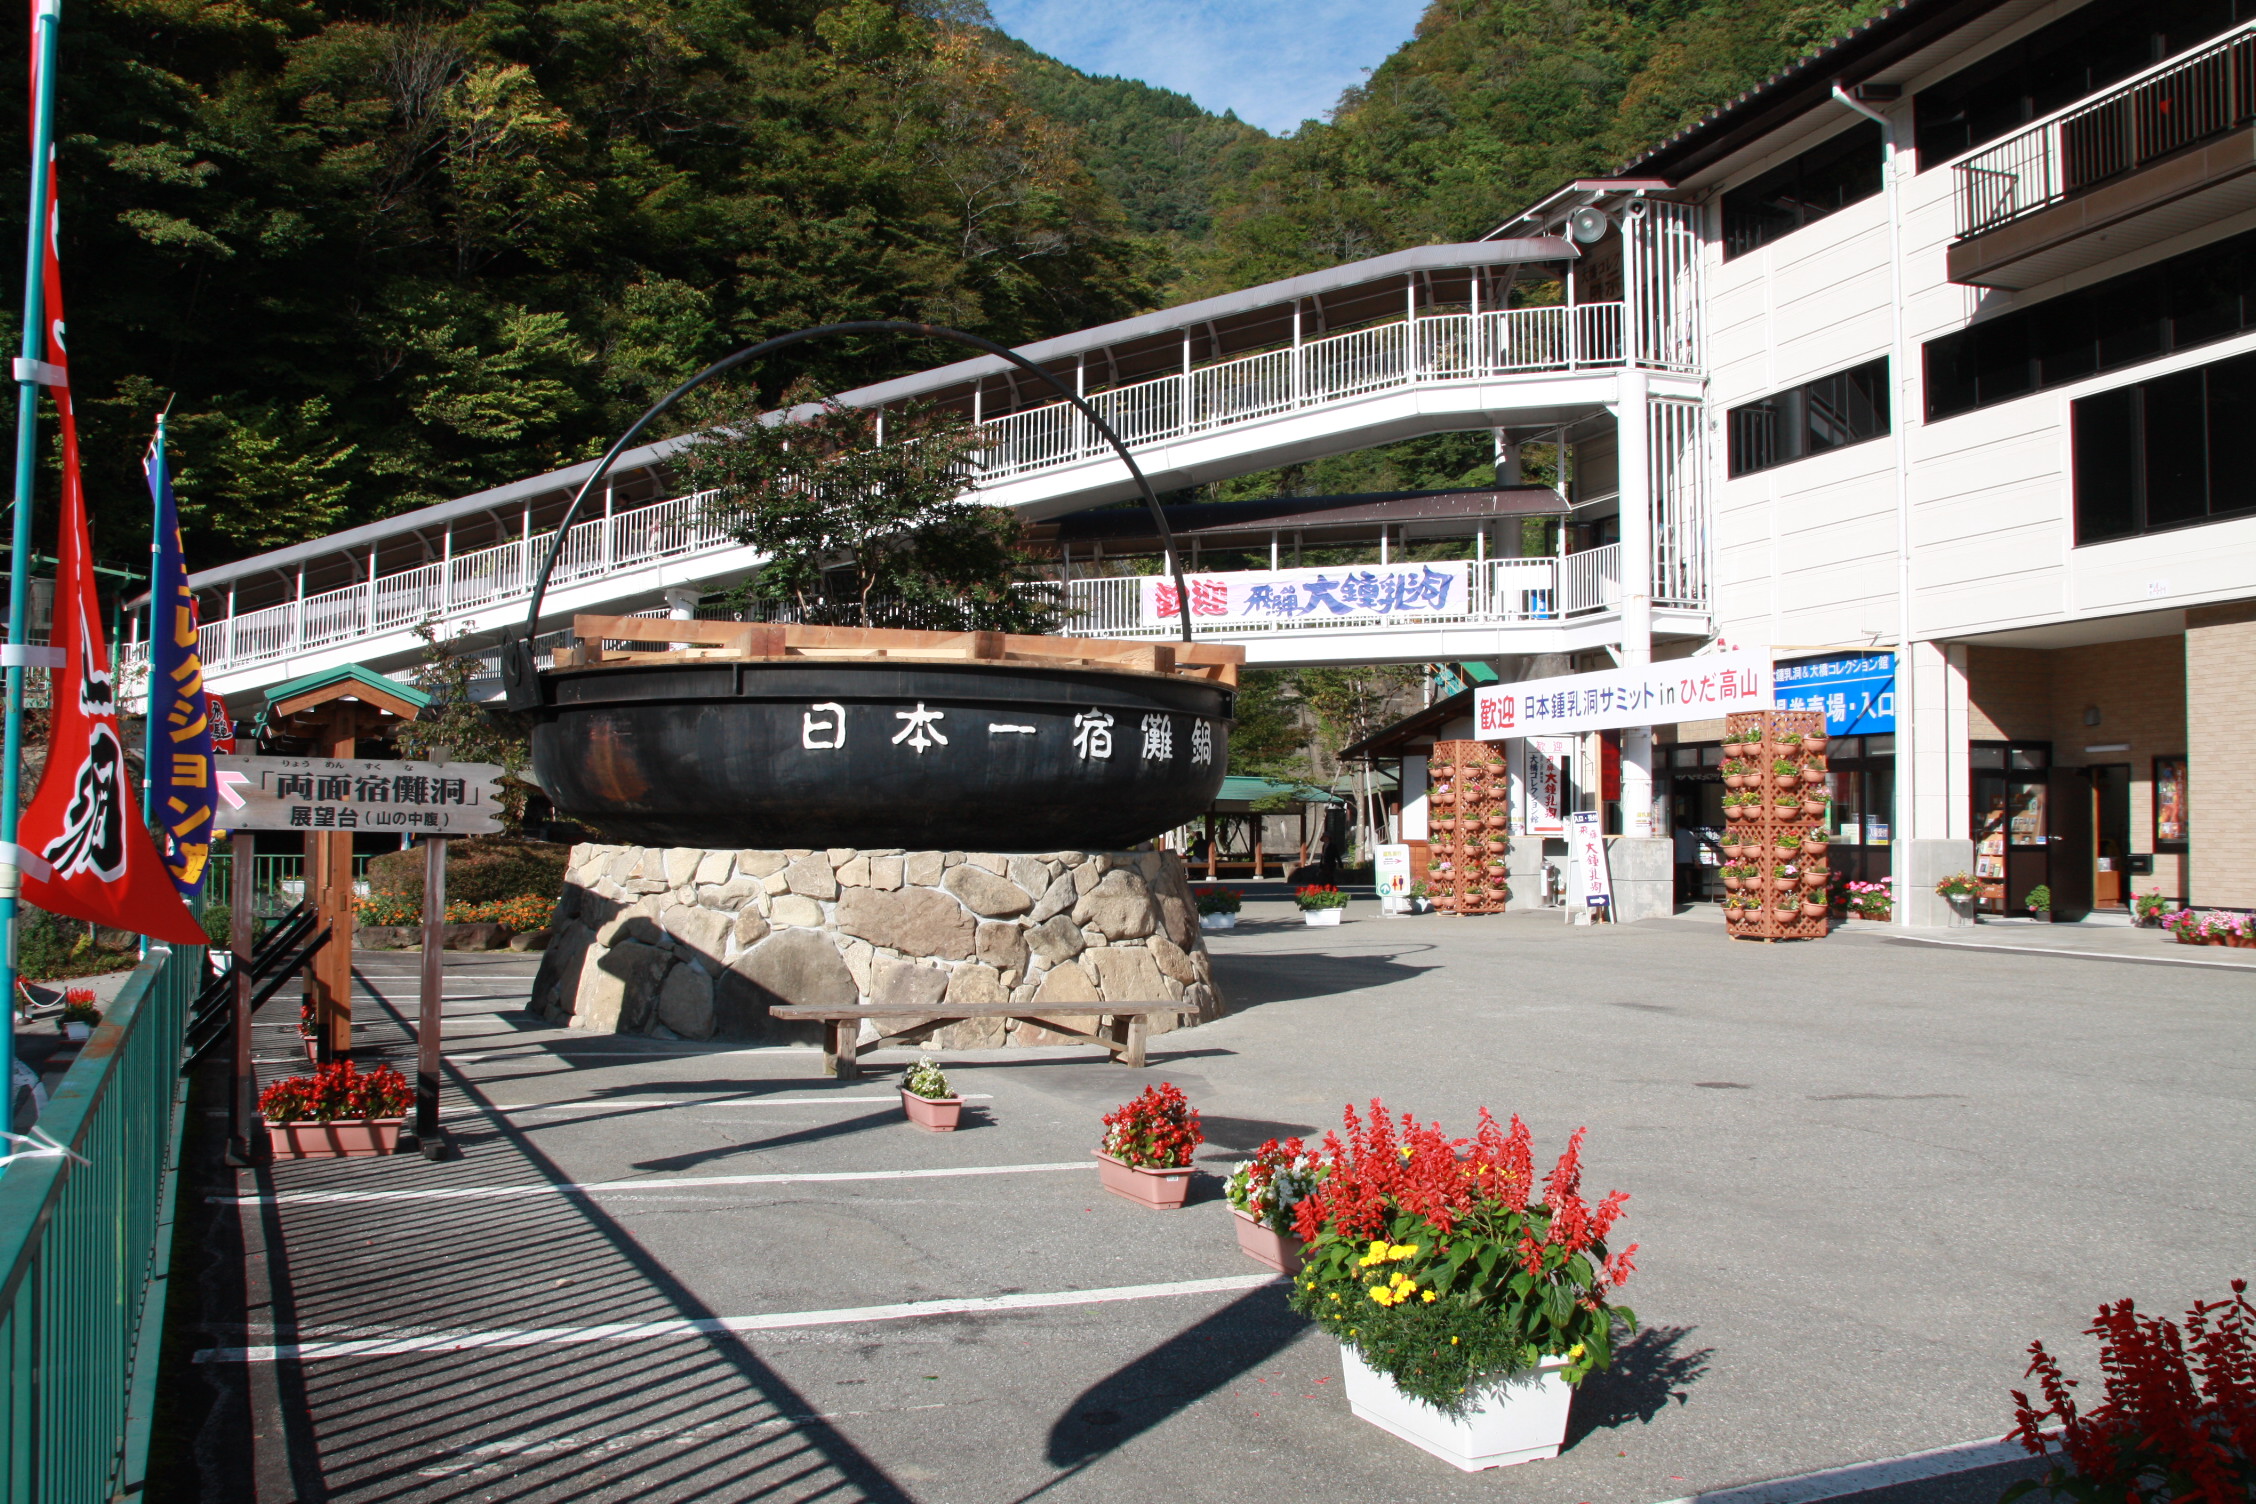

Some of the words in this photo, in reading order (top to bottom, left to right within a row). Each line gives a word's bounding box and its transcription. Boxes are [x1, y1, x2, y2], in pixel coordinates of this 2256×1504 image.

[1480, 695, 1515, 730] 歓迎
[1525, 682, 1654, 720] 日本鍾乳洞サミット
[1660, 683, 1675, 705] in
[1680, 668, 1758, 704] ひだ高山
[282, 759, 311, 768] りょう
[325, 761, 345, 769] めん
[364, 762, 381, 770] すく
